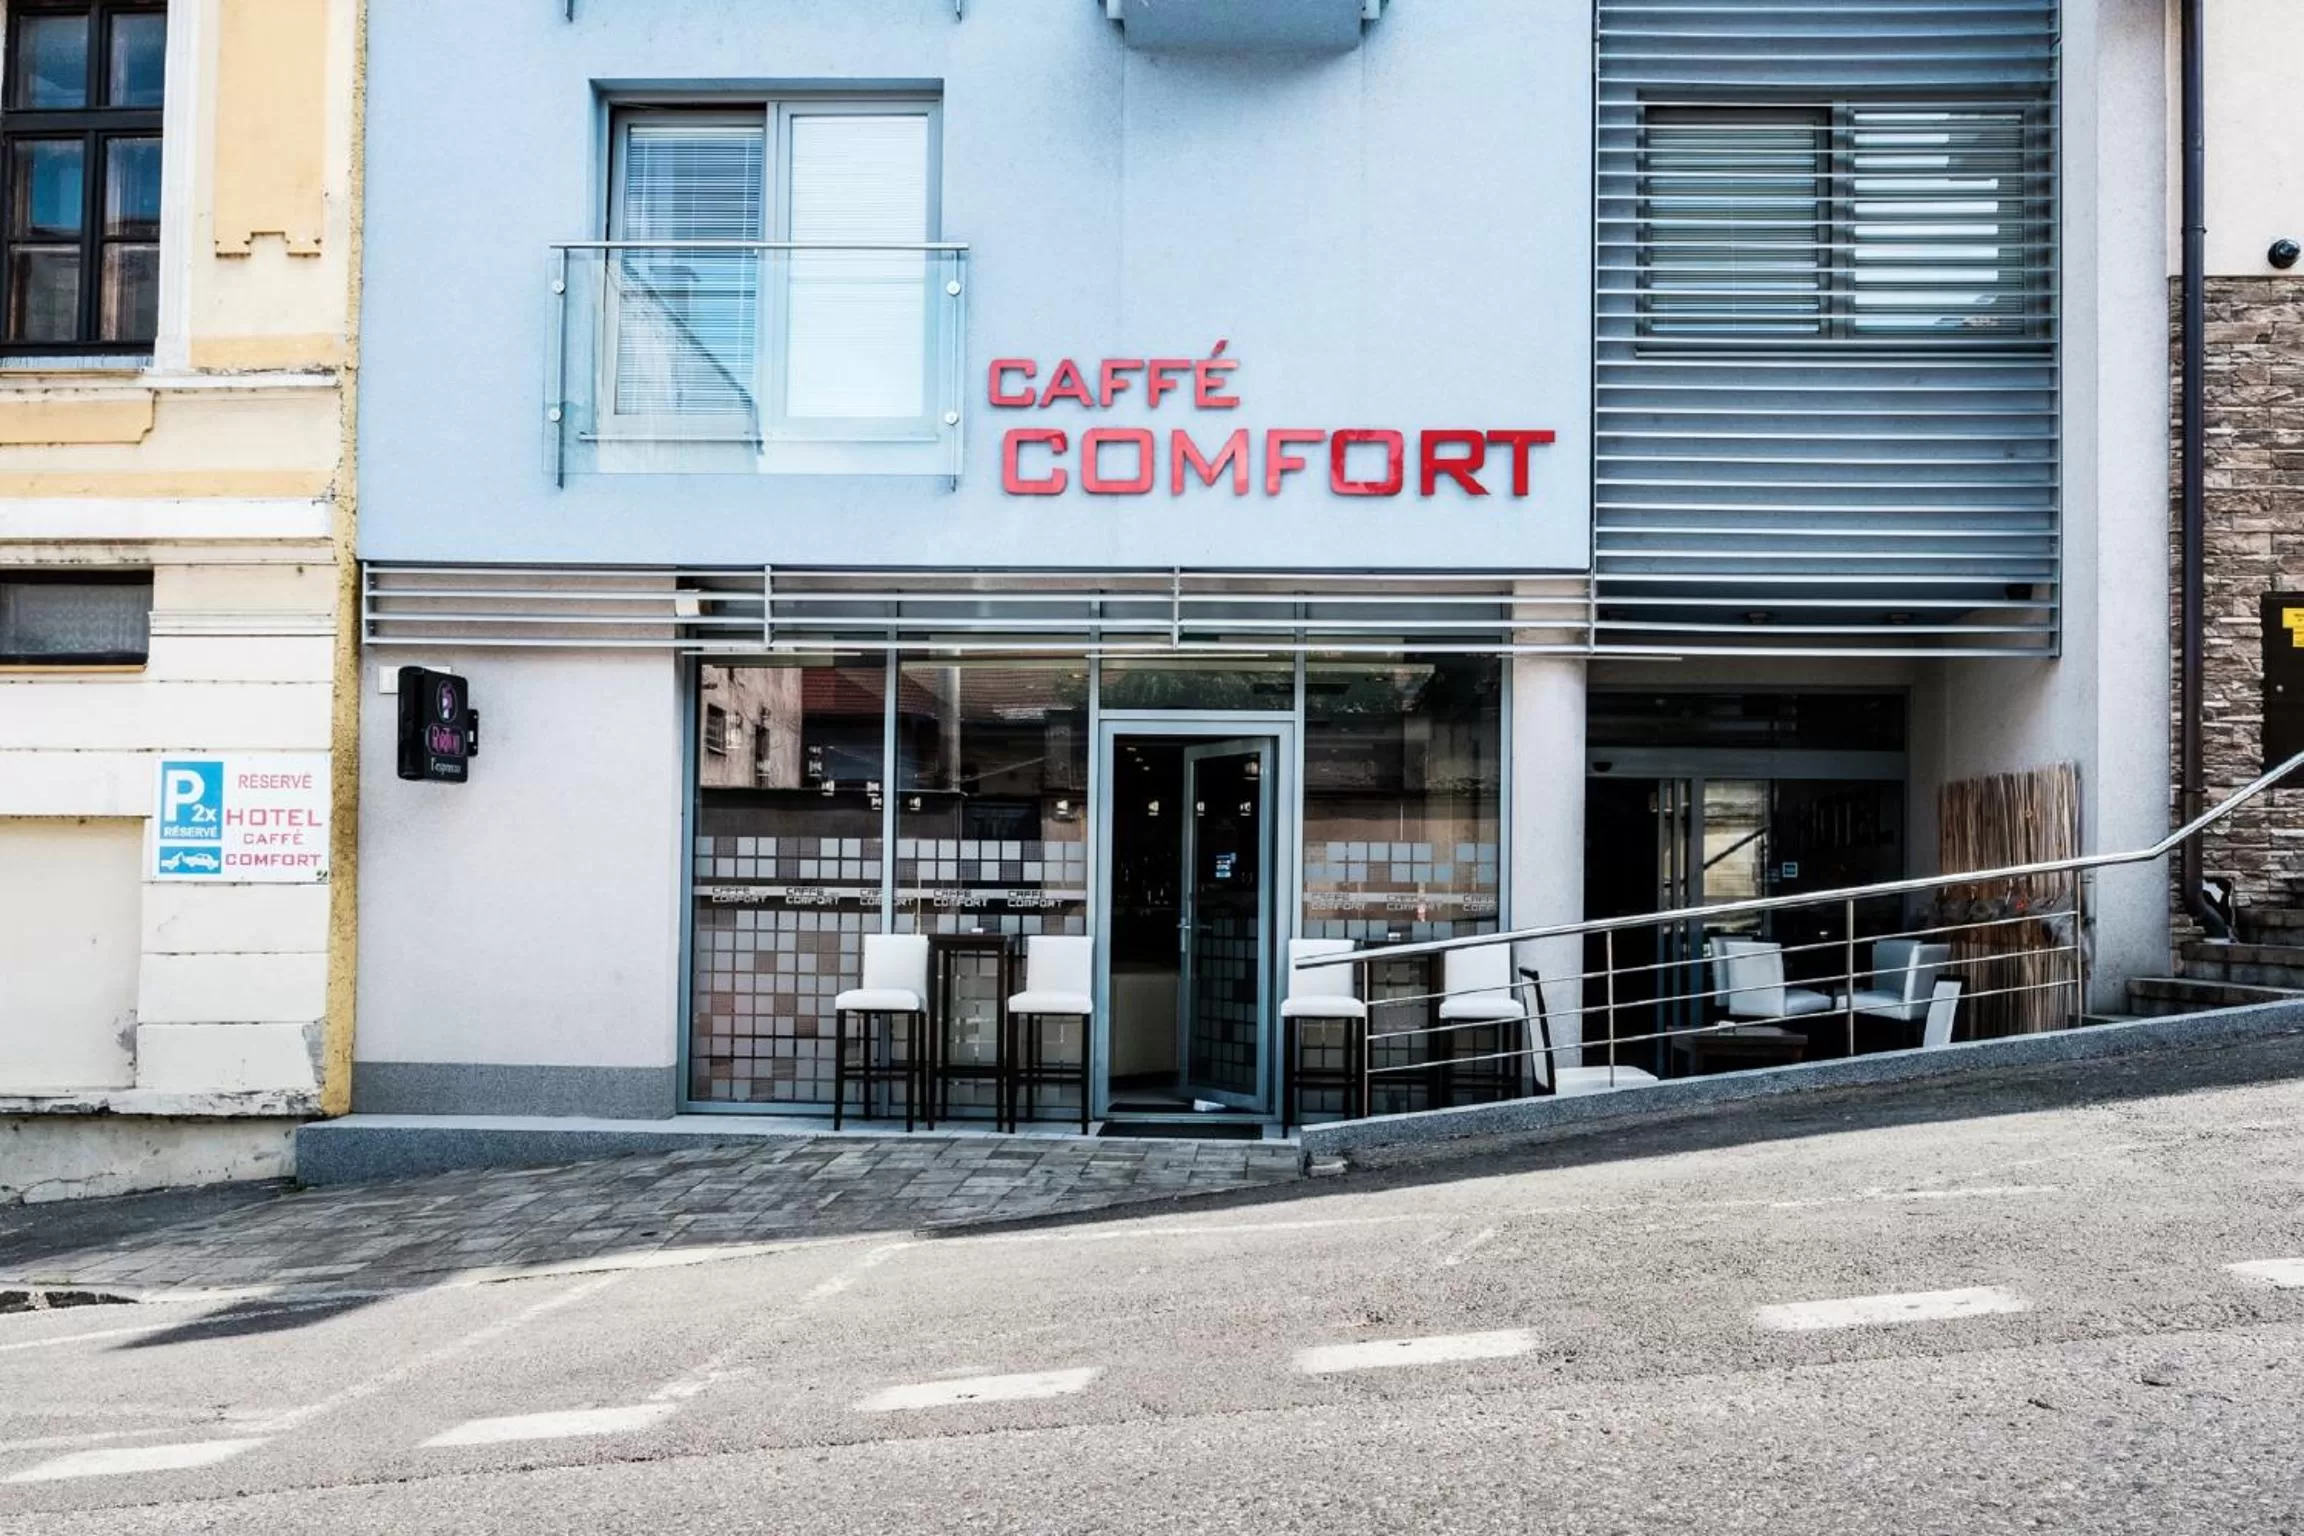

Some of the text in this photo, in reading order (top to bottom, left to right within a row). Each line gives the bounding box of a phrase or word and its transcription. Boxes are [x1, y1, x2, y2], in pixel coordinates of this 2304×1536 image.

[987, 340, 1240, 408] CAFFÉ
[1002, 428, 1556, 497] COMFORT
[163, 769, 218, 823] P 2x
[226, 808, 323, 827] HOTEL
[243, 829, 304, 846] CAFFÉ
[225, 853, 322, 867] COMFORT
[860, 897, 915, 906] COMORT
